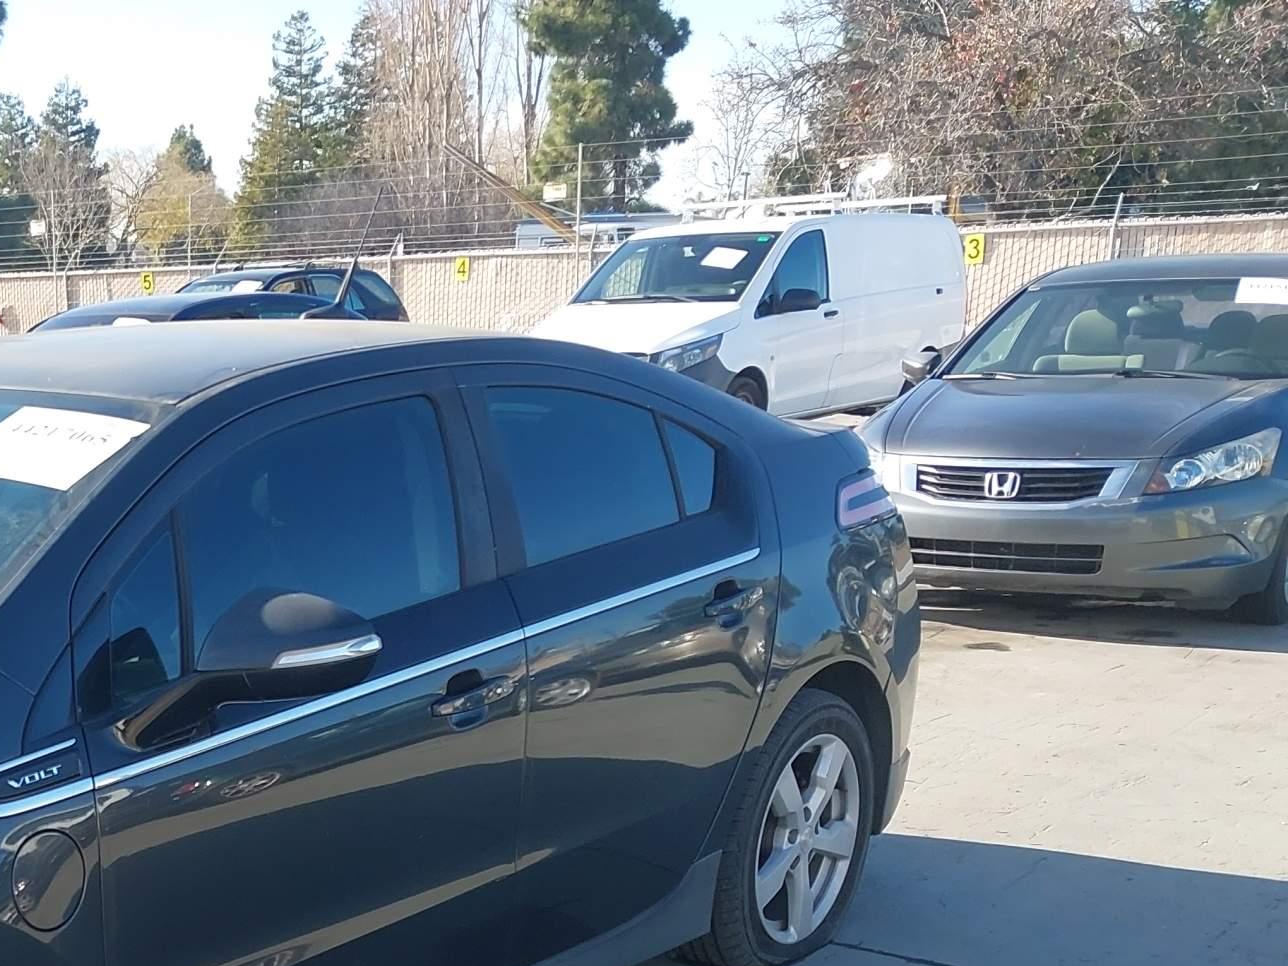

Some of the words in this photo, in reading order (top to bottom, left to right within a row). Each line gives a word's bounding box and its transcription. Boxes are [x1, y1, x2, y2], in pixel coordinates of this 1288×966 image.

[967, 238, 980, 259] 3
[456, 259, 467, 277] 4
[143, 274, 152, 290] 5
[7, 764, 62, 789] VOLT
